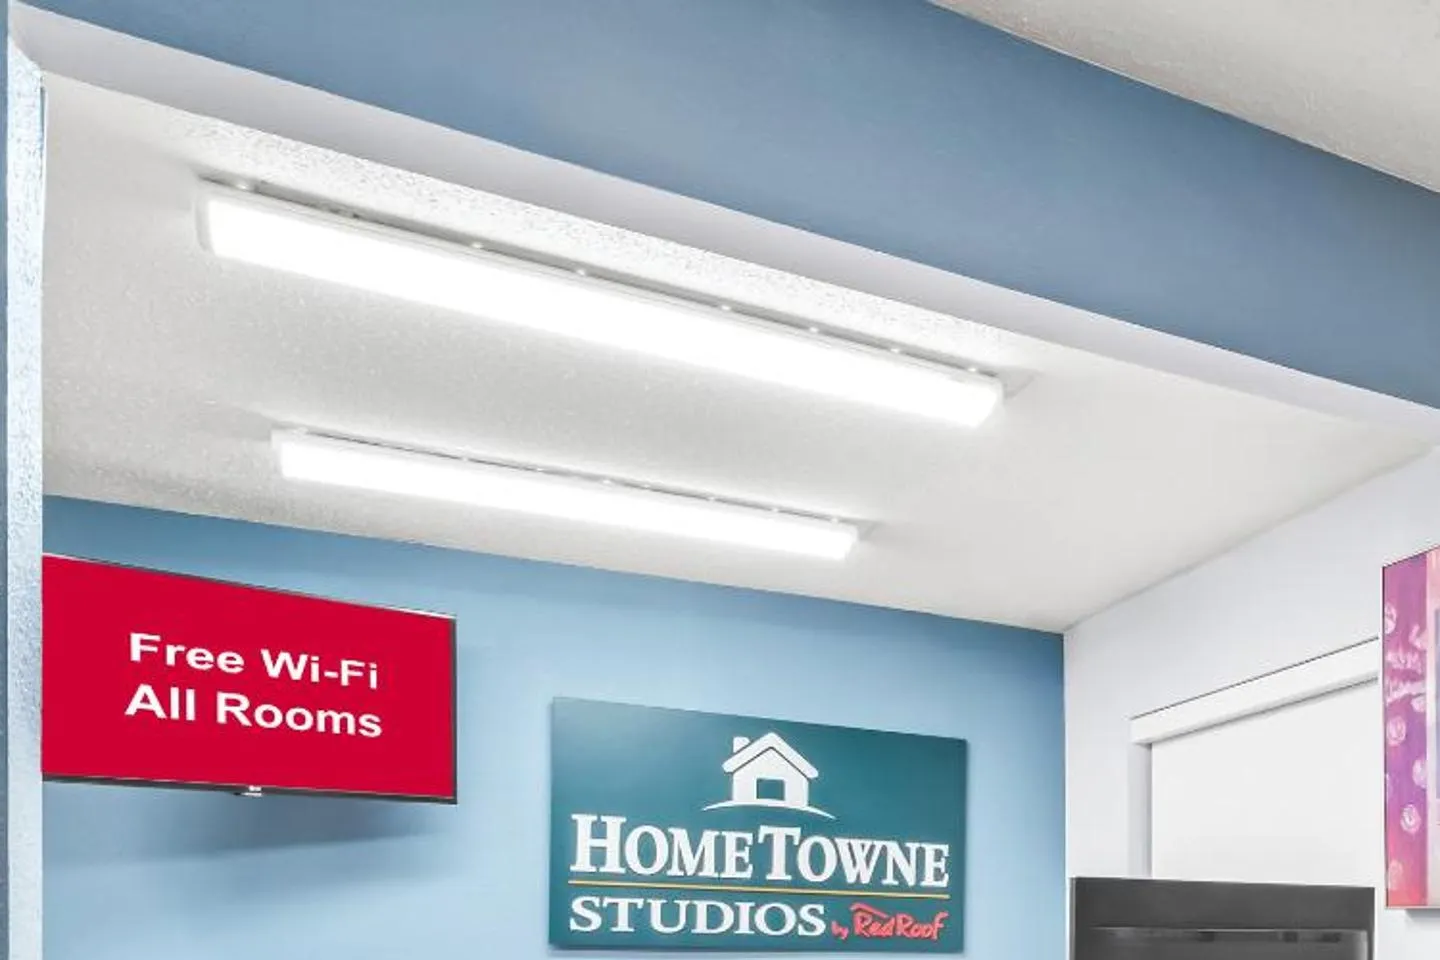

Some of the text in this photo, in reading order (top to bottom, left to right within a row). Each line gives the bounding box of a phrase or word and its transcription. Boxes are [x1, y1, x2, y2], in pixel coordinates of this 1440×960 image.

[129, 632, 380, 690] Free Wi-Fi
[124, 683, 384, 738] All Rooms
[569, 896, 826, 936] STUDIOS
[831, 920, 849, 940] by
